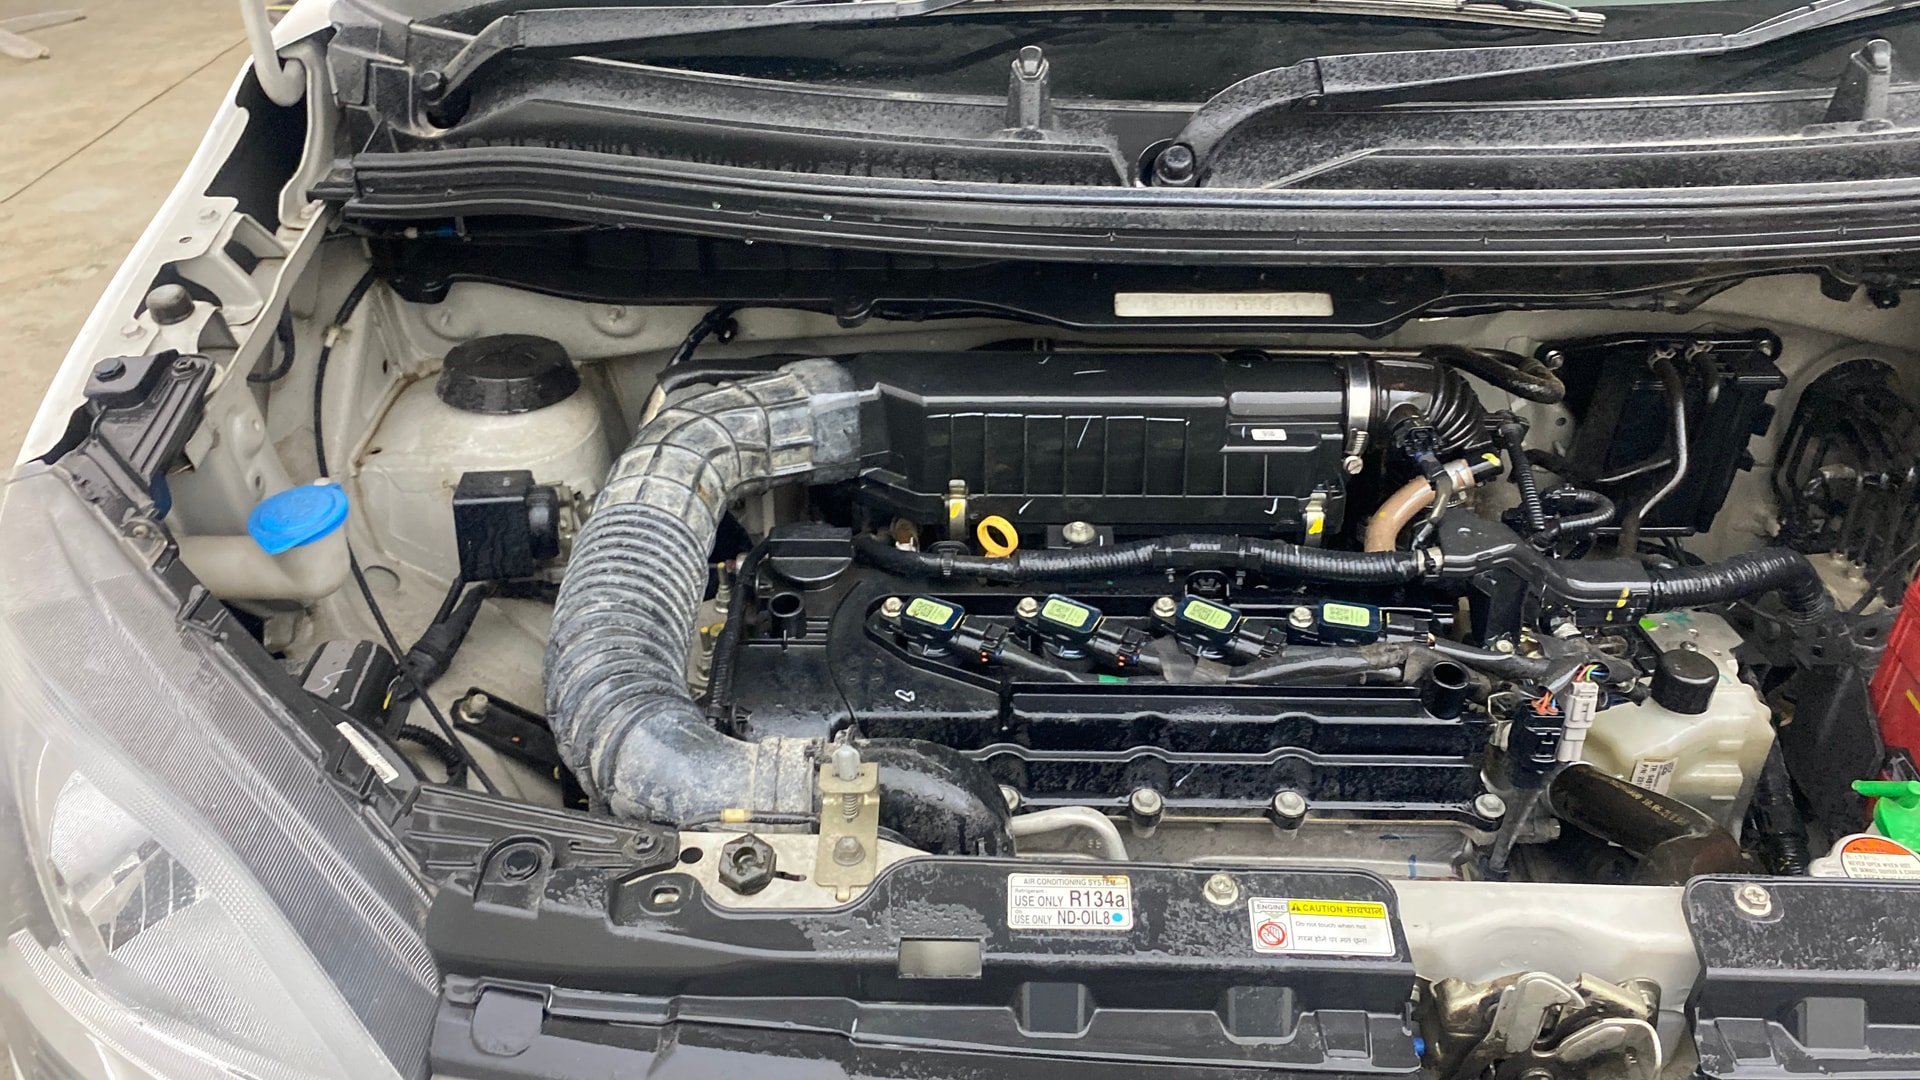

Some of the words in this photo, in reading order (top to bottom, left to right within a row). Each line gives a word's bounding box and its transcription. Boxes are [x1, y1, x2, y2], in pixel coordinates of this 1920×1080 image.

[1036, 878, 1086, 886] CONDITIONING
[1014, 895, 1035, 907] USE
[1037, 895, 1064, 907] ONLY
[1069, 890, 1125, 907] R134a
[1302, 903, 1343, 913] CAUTION
[1346, 905, 1382, 915] सावधान
[1014, 915, 1030, 924] USE
[1032, 915, 1052, 924] ONLY
[1057, 910, 1110, 925] ND-OIL8
